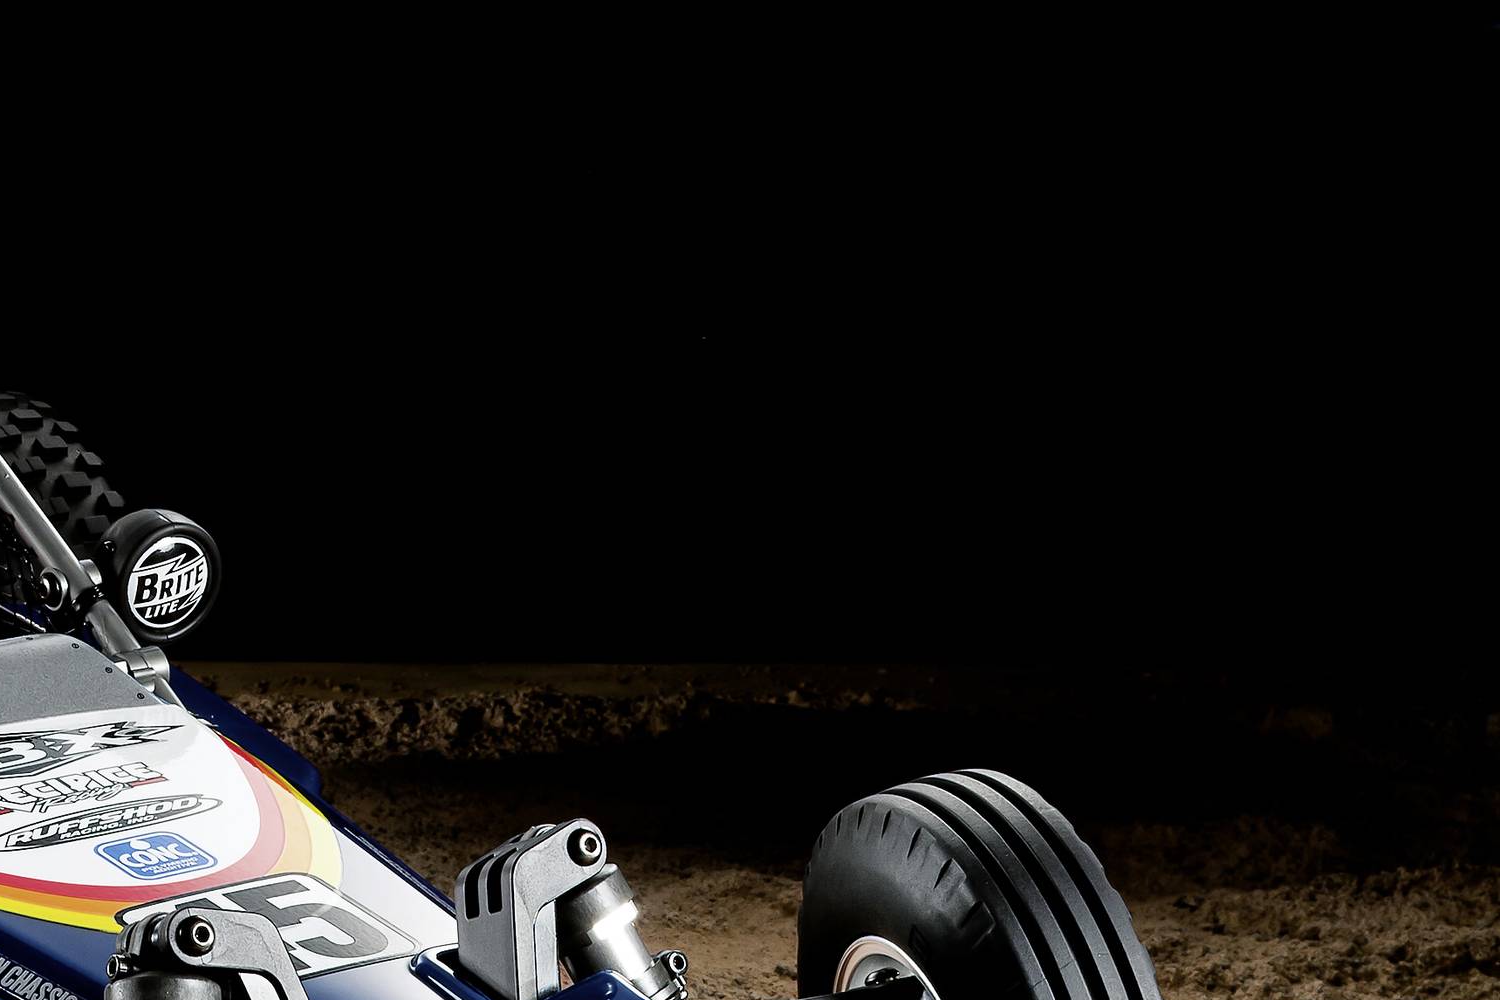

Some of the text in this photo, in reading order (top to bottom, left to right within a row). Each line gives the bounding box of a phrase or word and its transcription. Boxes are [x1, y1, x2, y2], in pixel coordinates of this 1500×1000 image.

[134, 561, 204, 605] BRITE
[144, 599, 180, 619] LITE
[5, 796, 199, 848] RUFFSHOD
